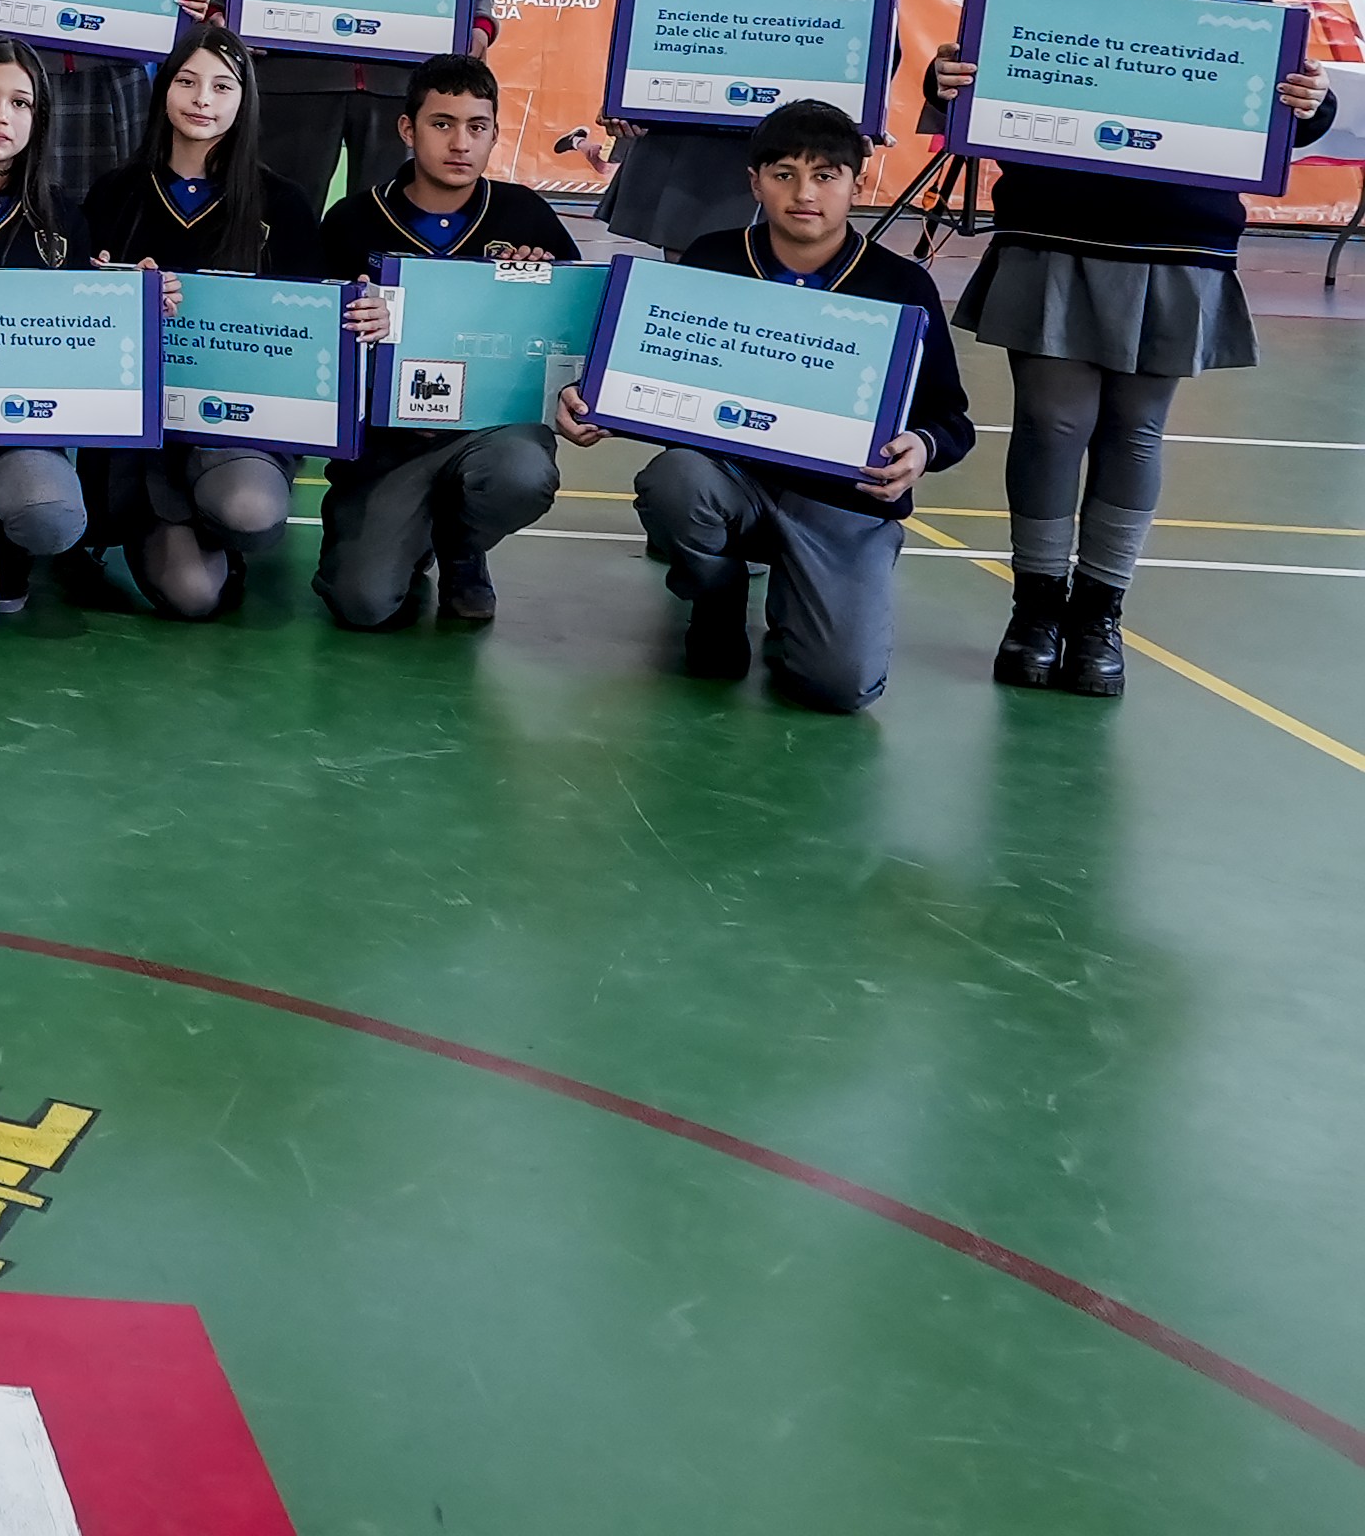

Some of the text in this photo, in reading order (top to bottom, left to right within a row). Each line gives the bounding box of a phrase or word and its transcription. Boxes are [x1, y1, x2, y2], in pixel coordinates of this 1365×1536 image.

[491, 5, 522, 20] JA
[657, 8, 845, 30] Enciende tu creatividad.
[655, 24, 825, 47] Dale clic al futuro que
[1011, 25, 1245, 65] Enciende tu creatividad.
[653, 40, 728, 56] imaginas.
[1008, 44, 1218, 82] Dale clic al futuro que
[1006, 63, 1098, 87] imaginas.
[0, 314, 17, 327] tu
[20, 315, 116, 329] creatividad.
[647, 304, 860, 356] Enciende tu creatividad.
[9, 332, 62, 347] futuro
[65, 336, 96, 350] que
[642, 322, 835, 370] Dale clic al futuro que
[639, 342, 723, 368] imaginas.
[409, 403, 450, 413] UN 3481
